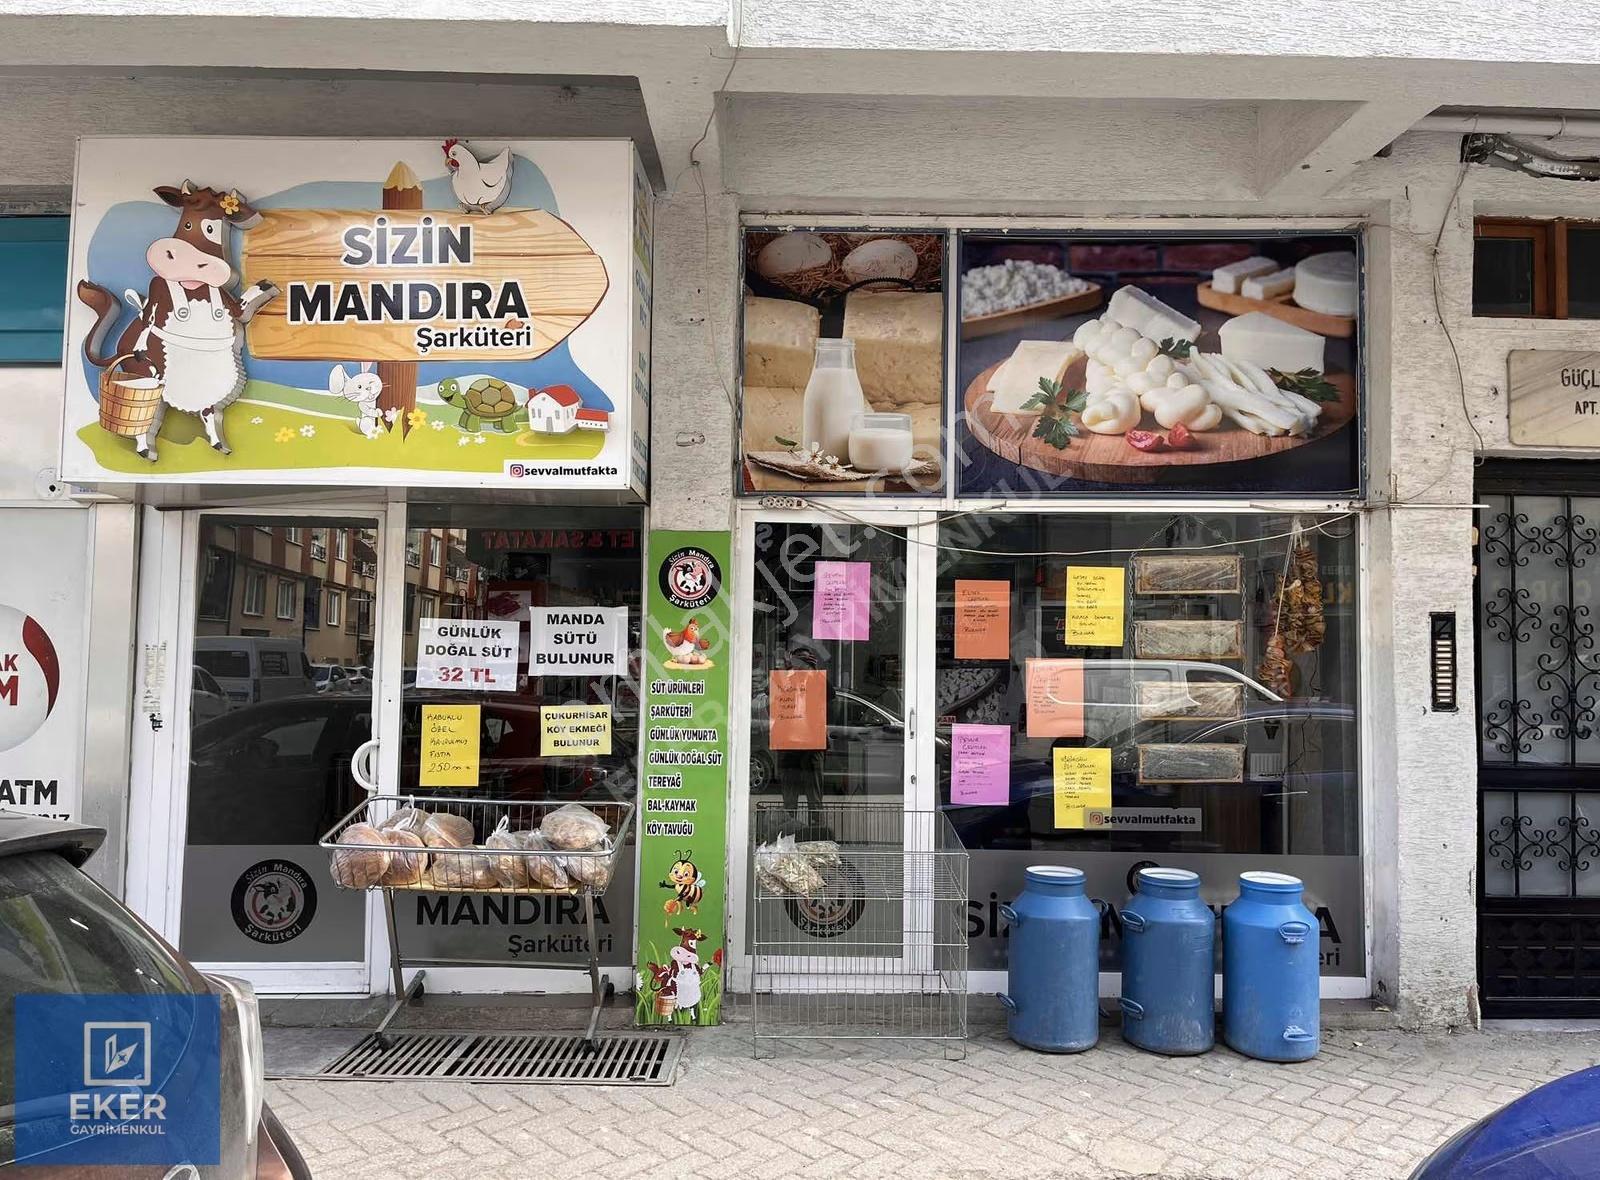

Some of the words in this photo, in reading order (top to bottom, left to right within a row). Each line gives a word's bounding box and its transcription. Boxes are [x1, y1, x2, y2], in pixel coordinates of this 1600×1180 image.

[343, 217, 471, 266] SİZİN
[290, 281, 529, 322] MANDIRA
[416, 326, 531, 353] Şarküteri
[1561, 368, 1600, 391] GÜÇL
[1575, 401, 1599, 415] APT.
[524, 466, 618, 476] sevvalmutfakta
[546, 614, 605, 625] MANDA
[438, 625, 501, 638] GÜNLÜK
[553, 631, 597, 644] SÜTÜ
[425, 643, 477, 657] DOĞAL
[481, 645, 513, 658] SÜT
[0, 654, 19, 672] K
[536, 653, 615, 665] BULUNUR
[438, 667, 463, 682] 32
[470, 668, 496, 683] TL
[651, 681, 666, 694] SÜT
[667, 680, 704, 694] ÜRÜNLERİ
[545, 711, 608, 721] ÇUKURHİSAR
[650, 704, 692, 720] ŞARKÜTERİ
[569, 724, 606, 733] EKMEĞİ
[650, 728, 683, 741] GÜNLÜK
[681, 730, 717, 741] YUMURTA
[553, 739, 599, 747] BULUNUR
[649, 751, 679, 764] GÜNLÜK
[680, 751, 707, 765] DOĞAL
[707, 753, 722, 765] SÜT
[648, 774, 681, 788] TEREYAĞ
[0, 780, 58, 805] ATM
[647, 799, 696, 812] BAL-KAYMAK
[1103, 814, 1196, 825] sevvalmutfakta
[646, 820, 662, 835] KÖY
[663, 820, 693, 835] TAVUĞU
[416, 895, 611, 926] MANDIRA
